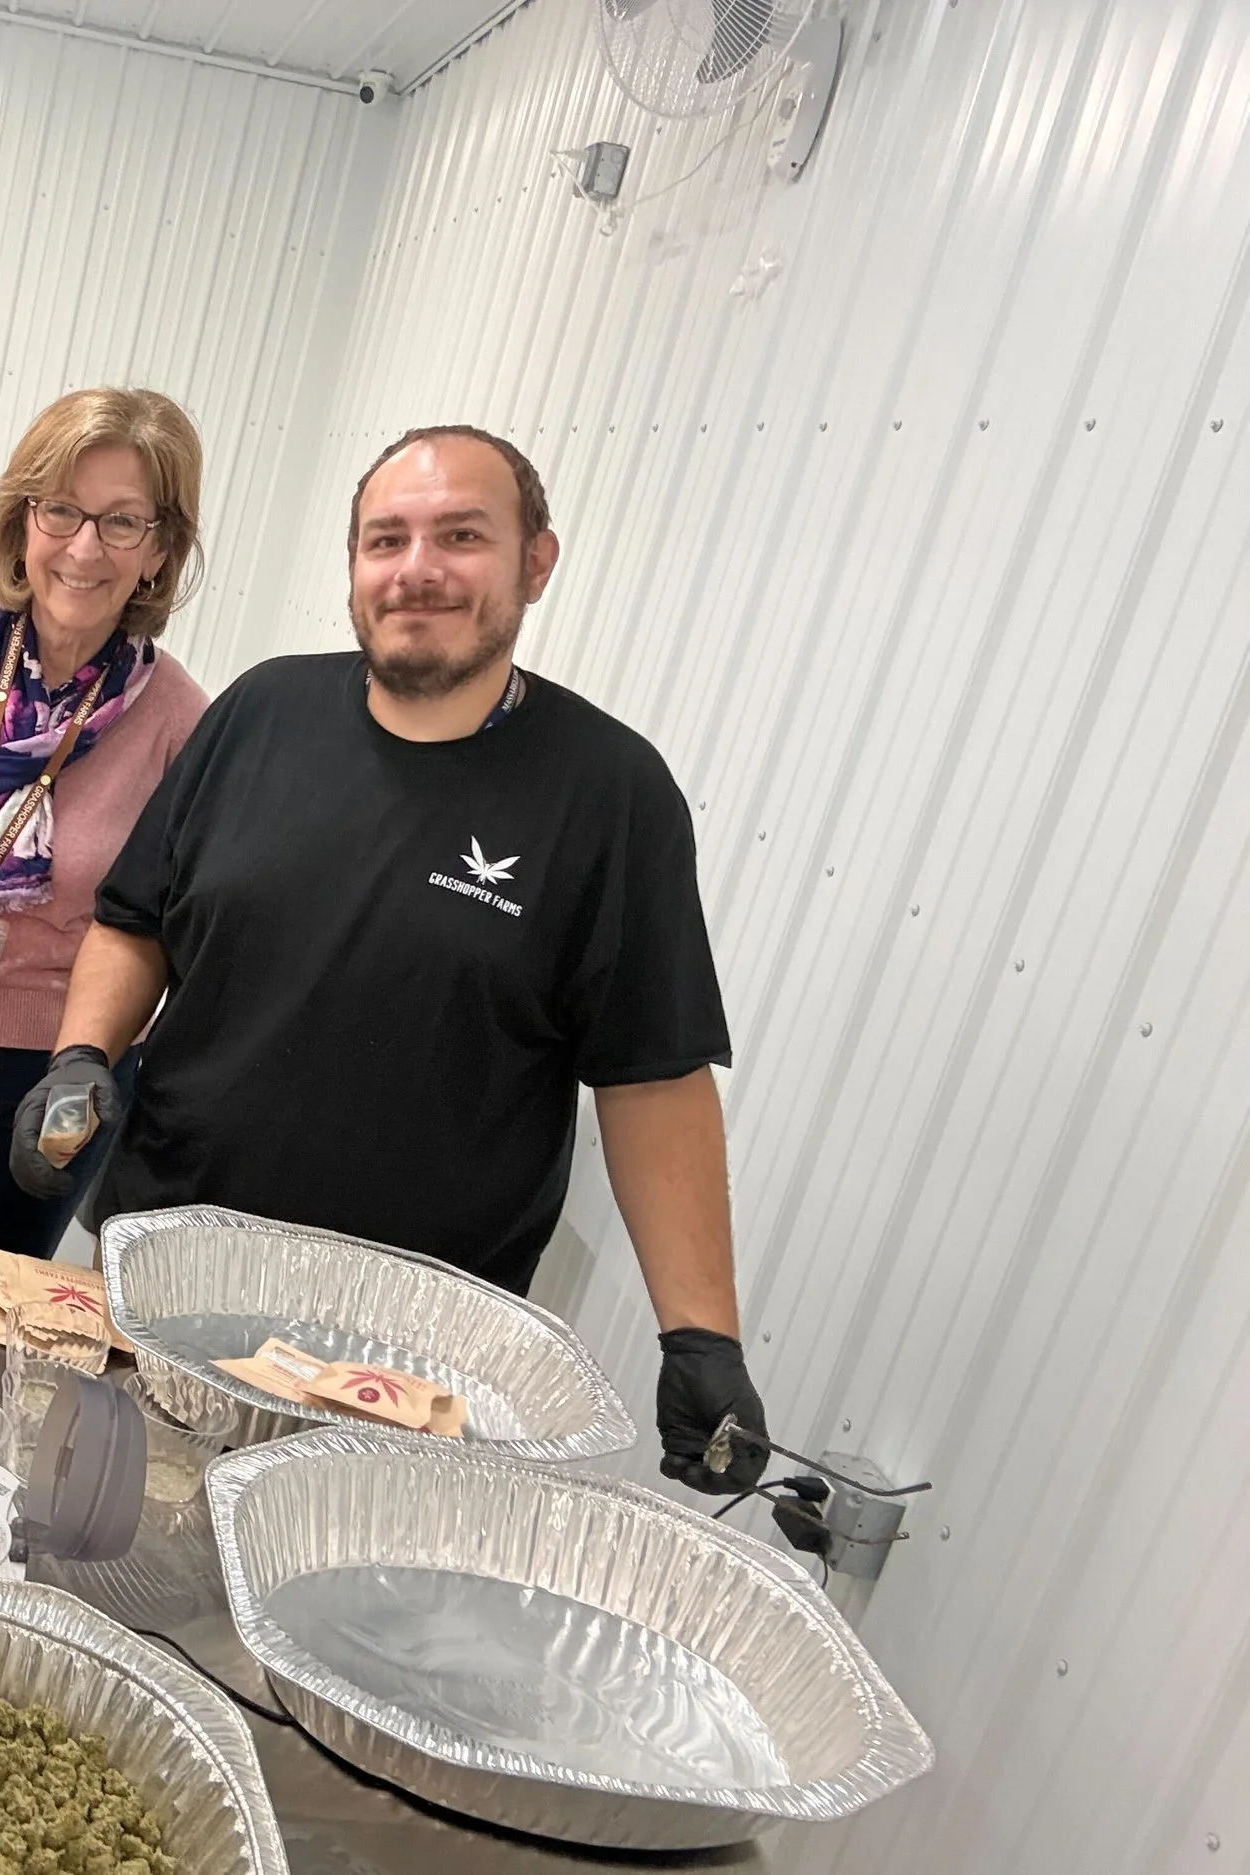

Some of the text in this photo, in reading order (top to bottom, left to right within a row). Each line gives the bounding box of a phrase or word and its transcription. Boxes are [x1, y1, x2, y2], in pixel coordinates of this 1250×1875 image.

[0, 636, 21, 690] GRASSHOPPER
[73, 702, 91, 726] FARMS
[6, 785, 44, 839] GRASSHOPPER
[428, 872, 523, 917] GRASSHOPPER FARMS
